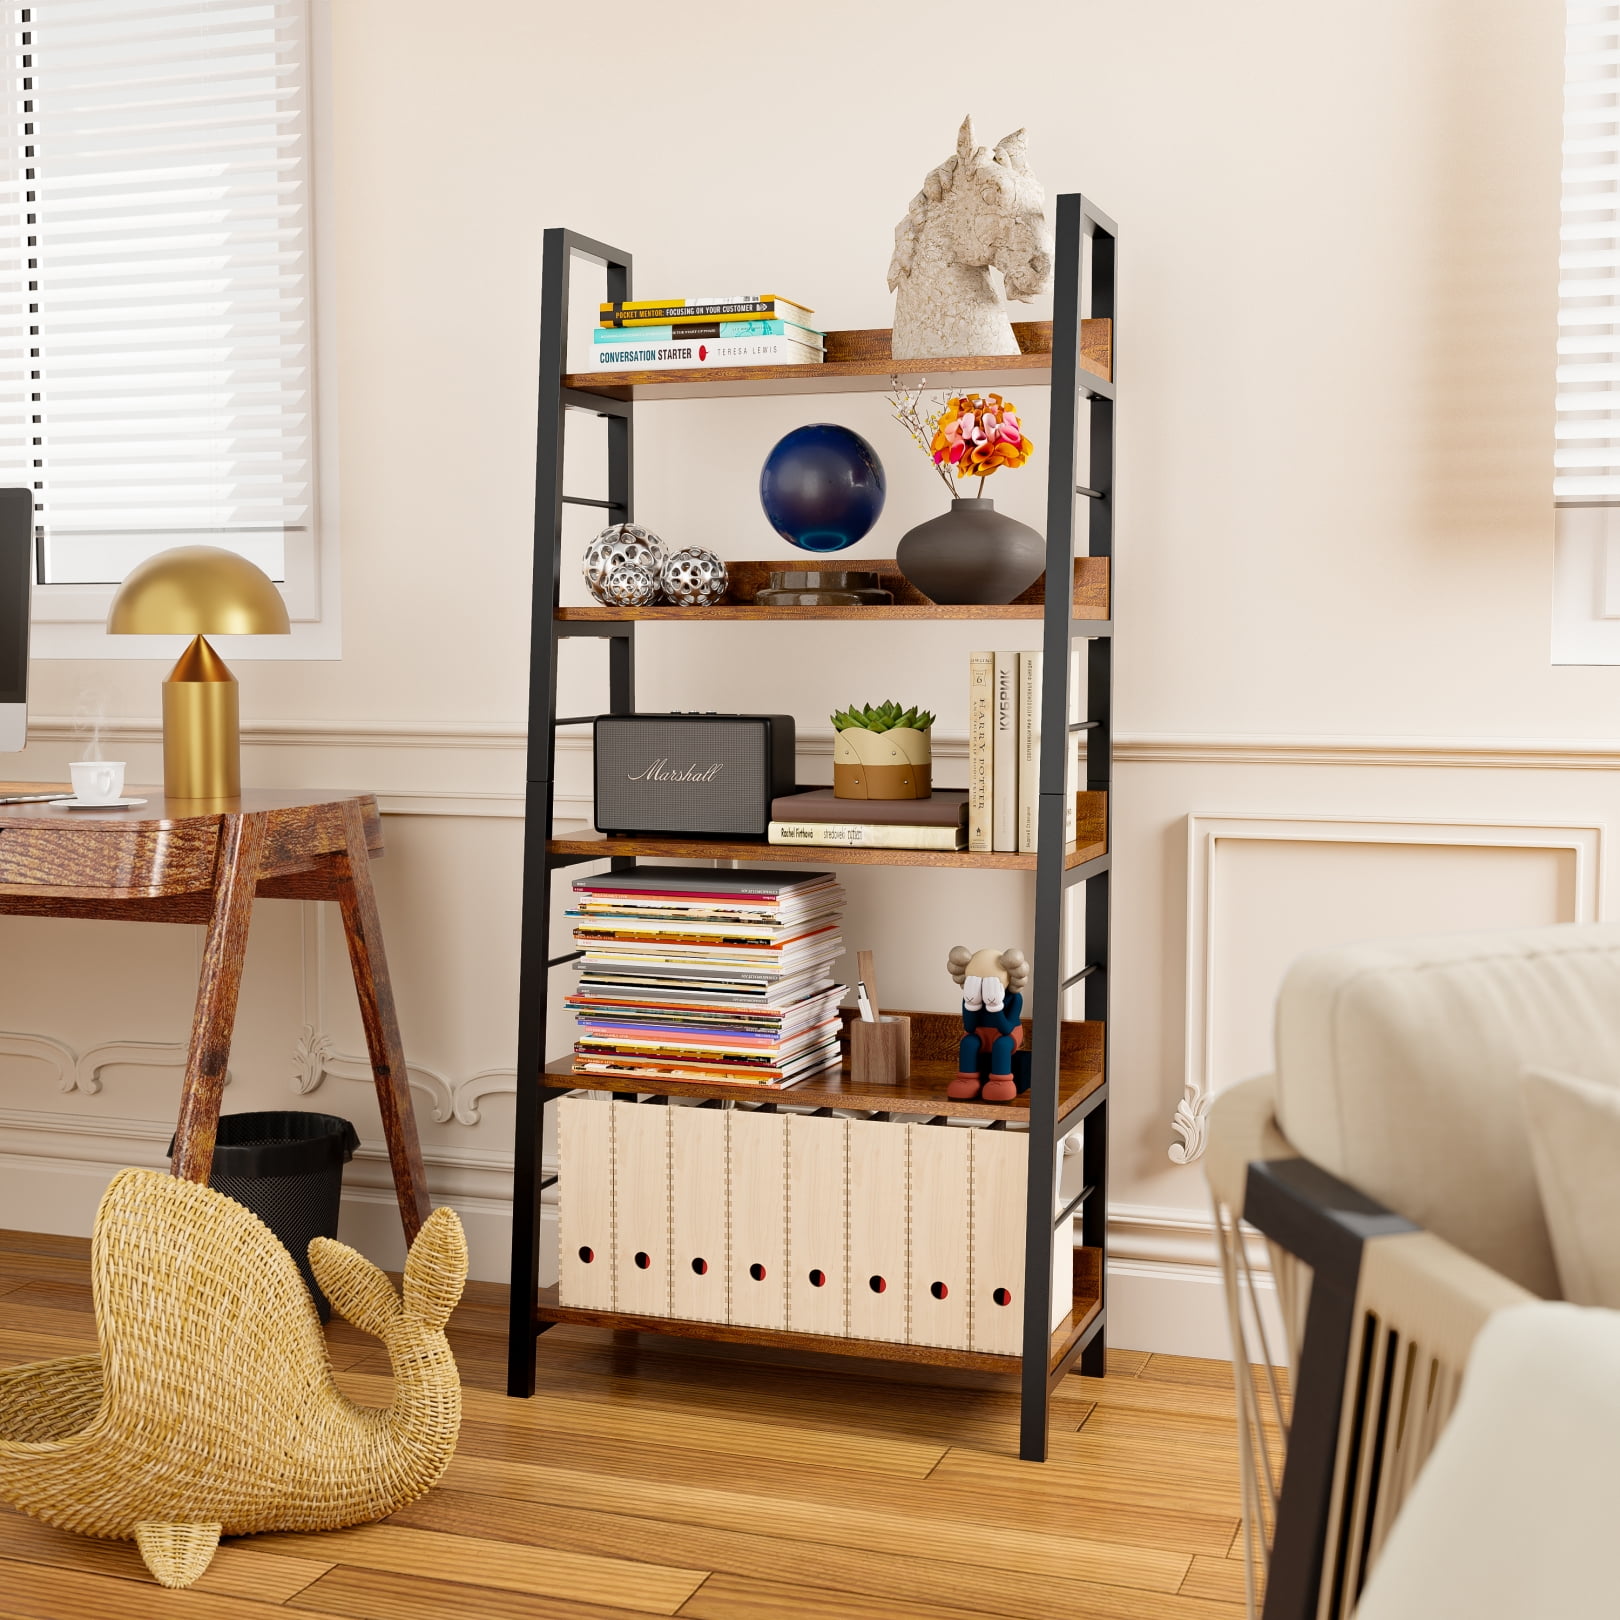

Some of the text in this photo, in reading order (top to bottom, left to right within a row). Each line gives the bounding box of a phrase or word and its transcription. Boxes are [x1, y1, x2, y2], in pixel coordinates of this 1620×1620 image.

[615, 304, 753, 319] POCKET MENTOR: FOCUSING ON YOUR CUSTOMER
[600, 348, 692, 364] CONVERSATION STARTER
[717, 345, 778, 357] TERESA LEWIS
[1000, 669, 1010, 731] КУБРИК
[627, 758, 724, 782] Marshall
[781, 827, 795, 838] Rachel
